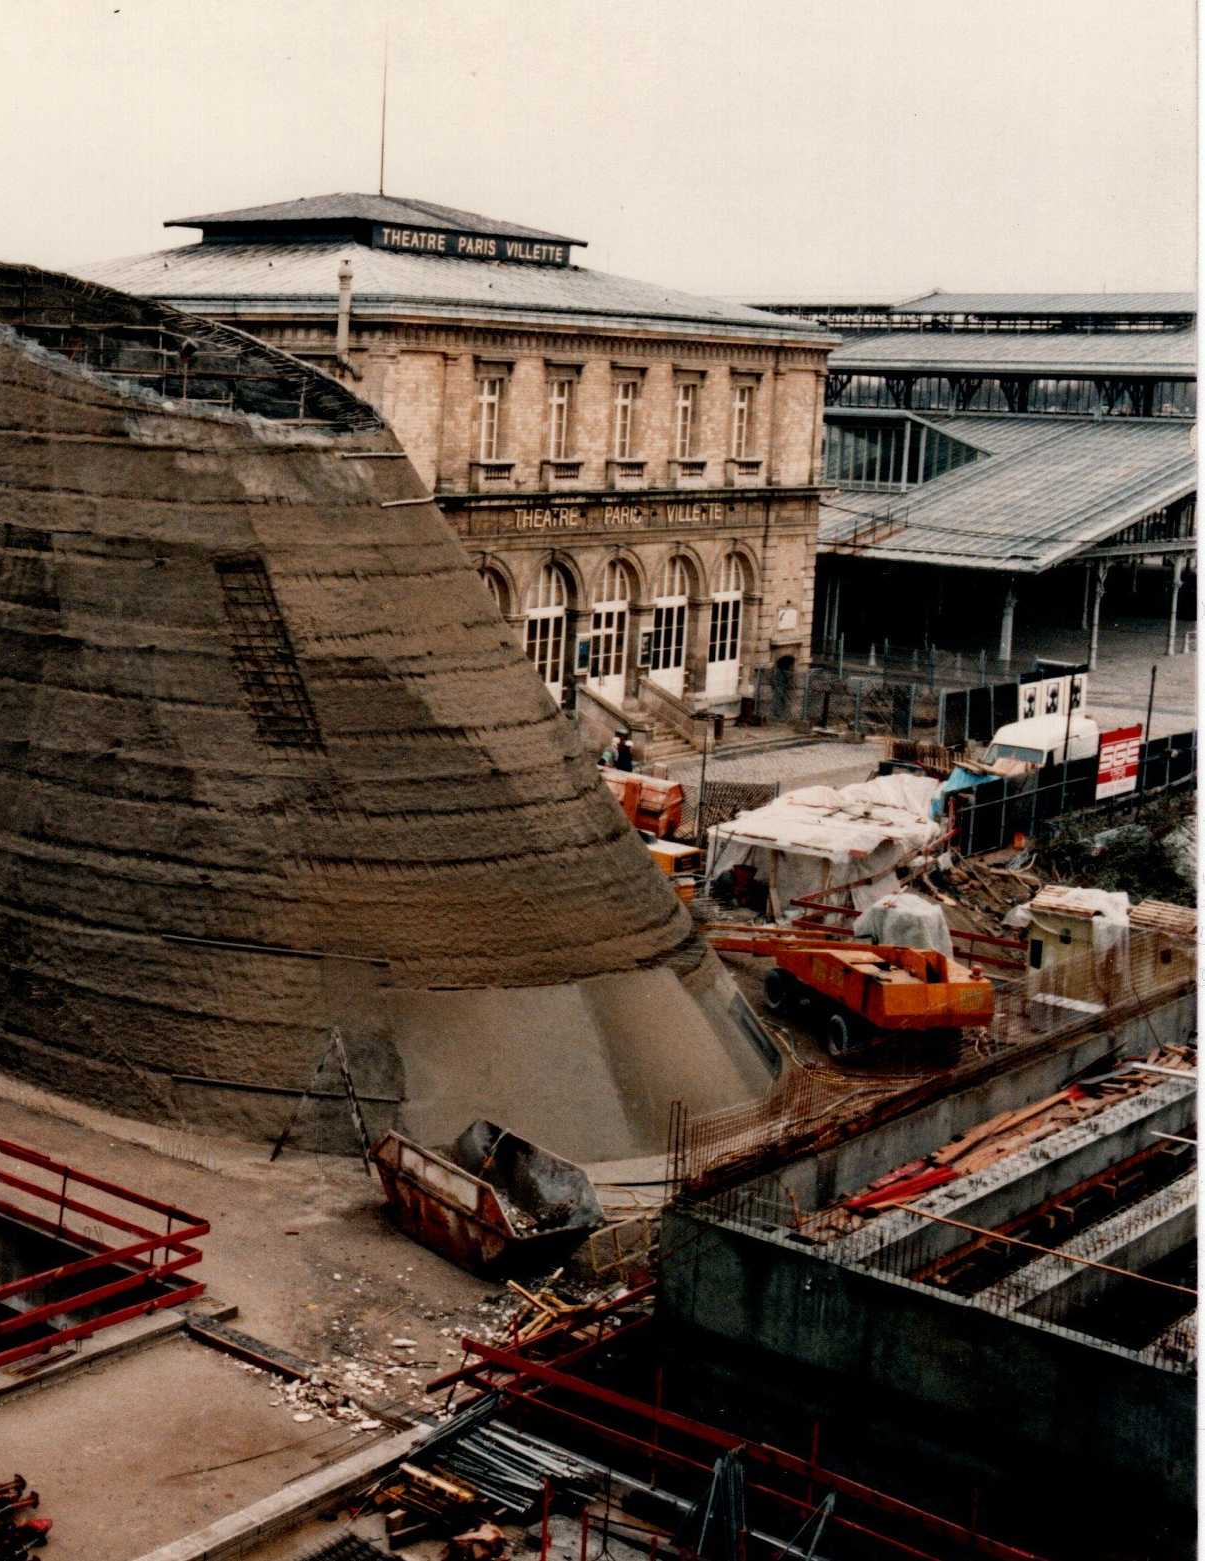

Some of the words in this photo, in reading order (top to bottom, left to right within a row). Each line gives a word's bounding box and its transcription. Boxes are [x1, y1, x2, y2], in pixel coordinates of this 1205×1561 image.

[382, 228, 445, 251] THEATRE
[458, 236, 496, 256] PARIS
[506, 241, 563, 262] VILLETTE
[515, 507, 579, 529] THEATRE
[666, 503, 722, 523] VILLETTE
[1099, 738, 1140, 770] SGE
